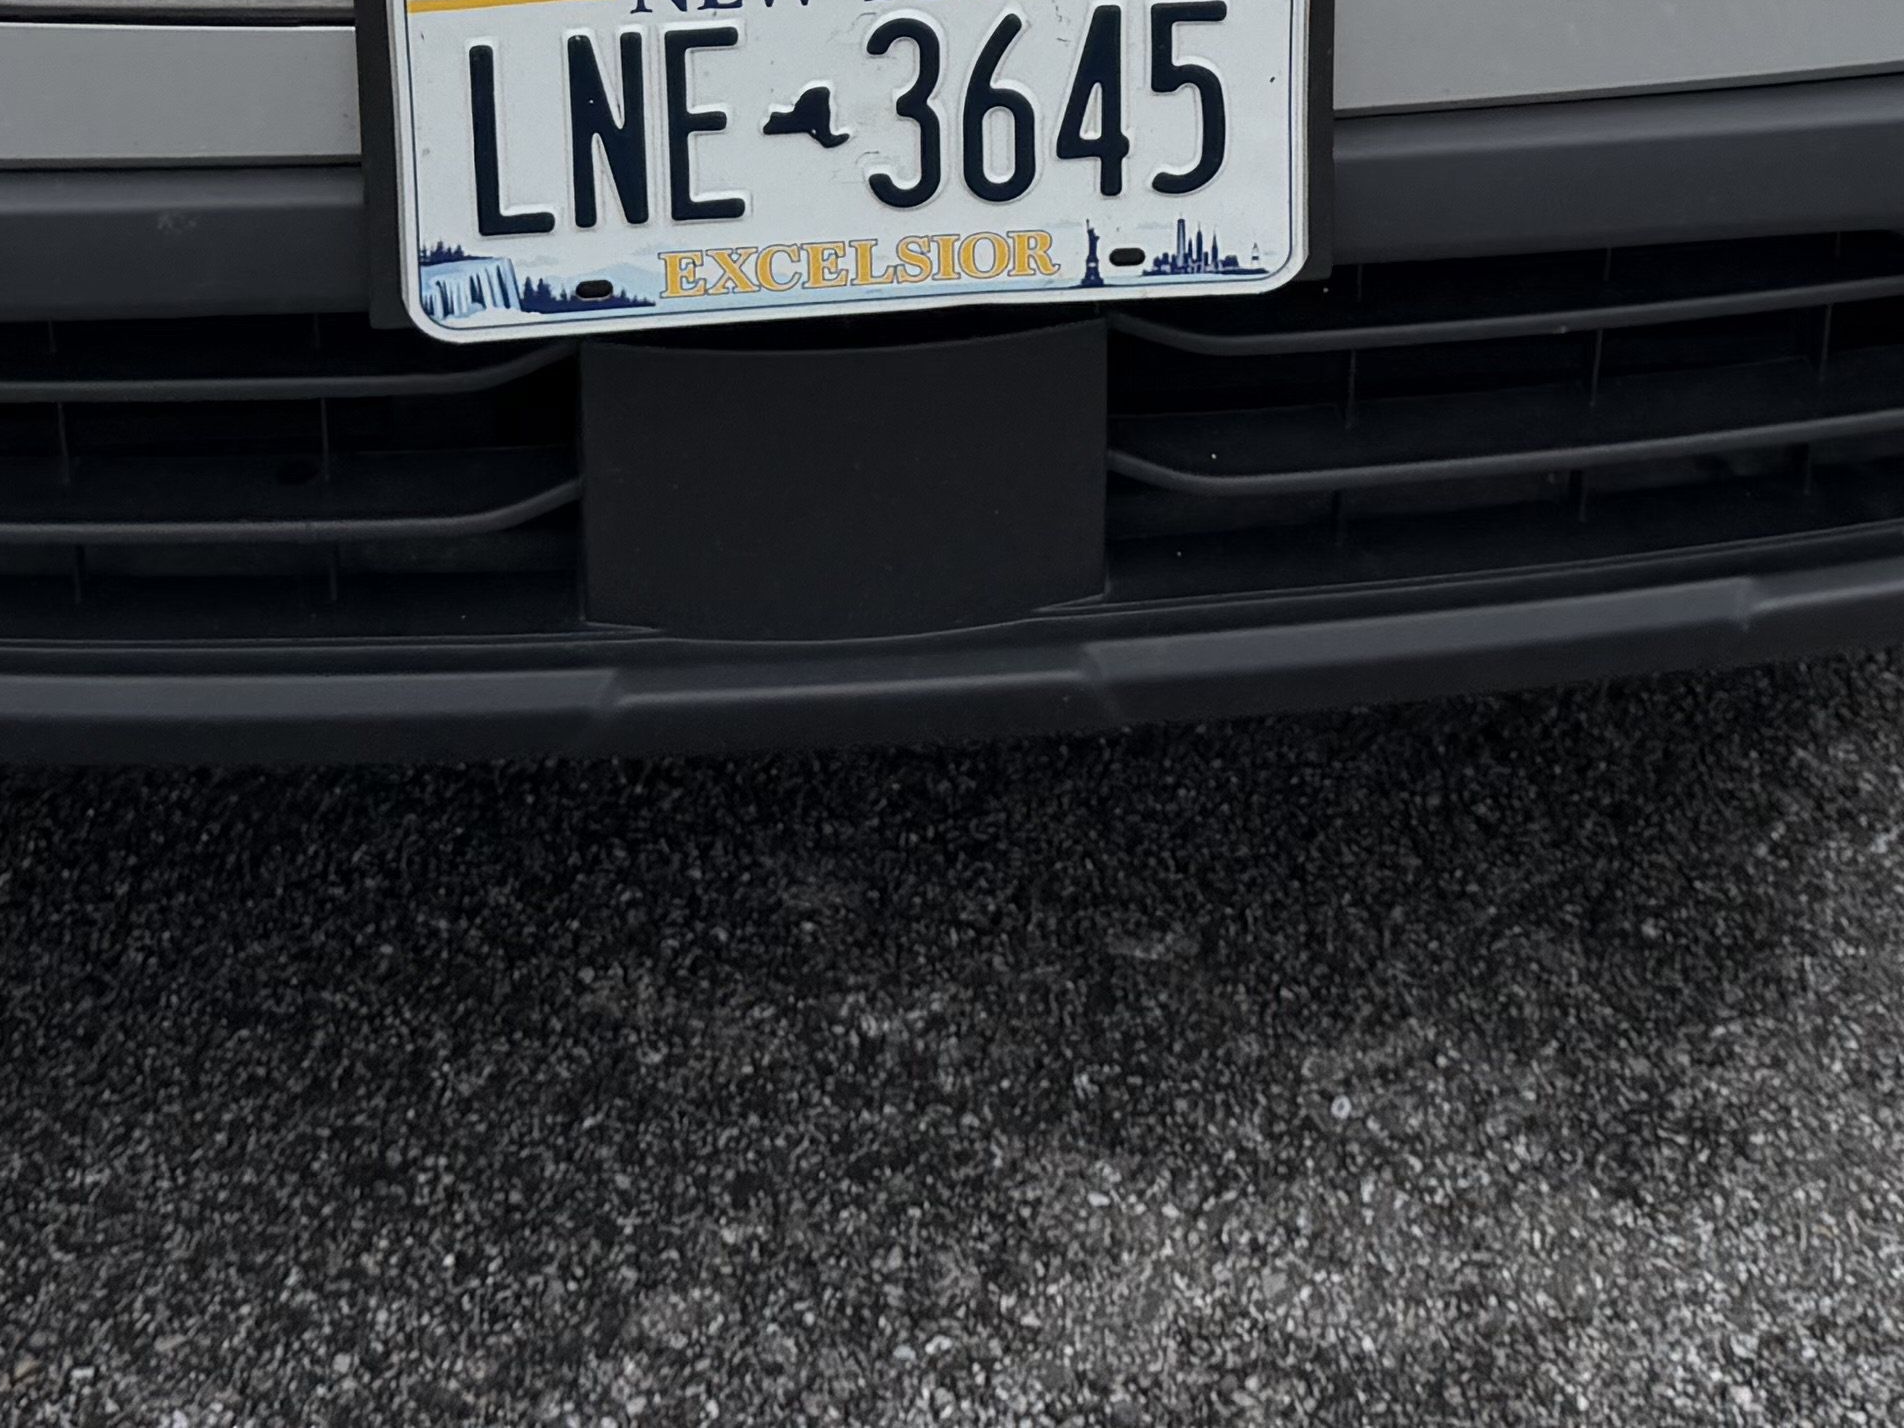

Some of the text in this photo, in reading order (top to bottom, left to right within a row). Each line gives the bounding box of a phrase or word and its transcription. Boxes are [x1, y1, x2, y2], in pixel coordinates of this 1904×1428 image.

[468, 0, 1229, 237] LNE 3645
[658, 228, 1061, 300] EXCELSIOR
